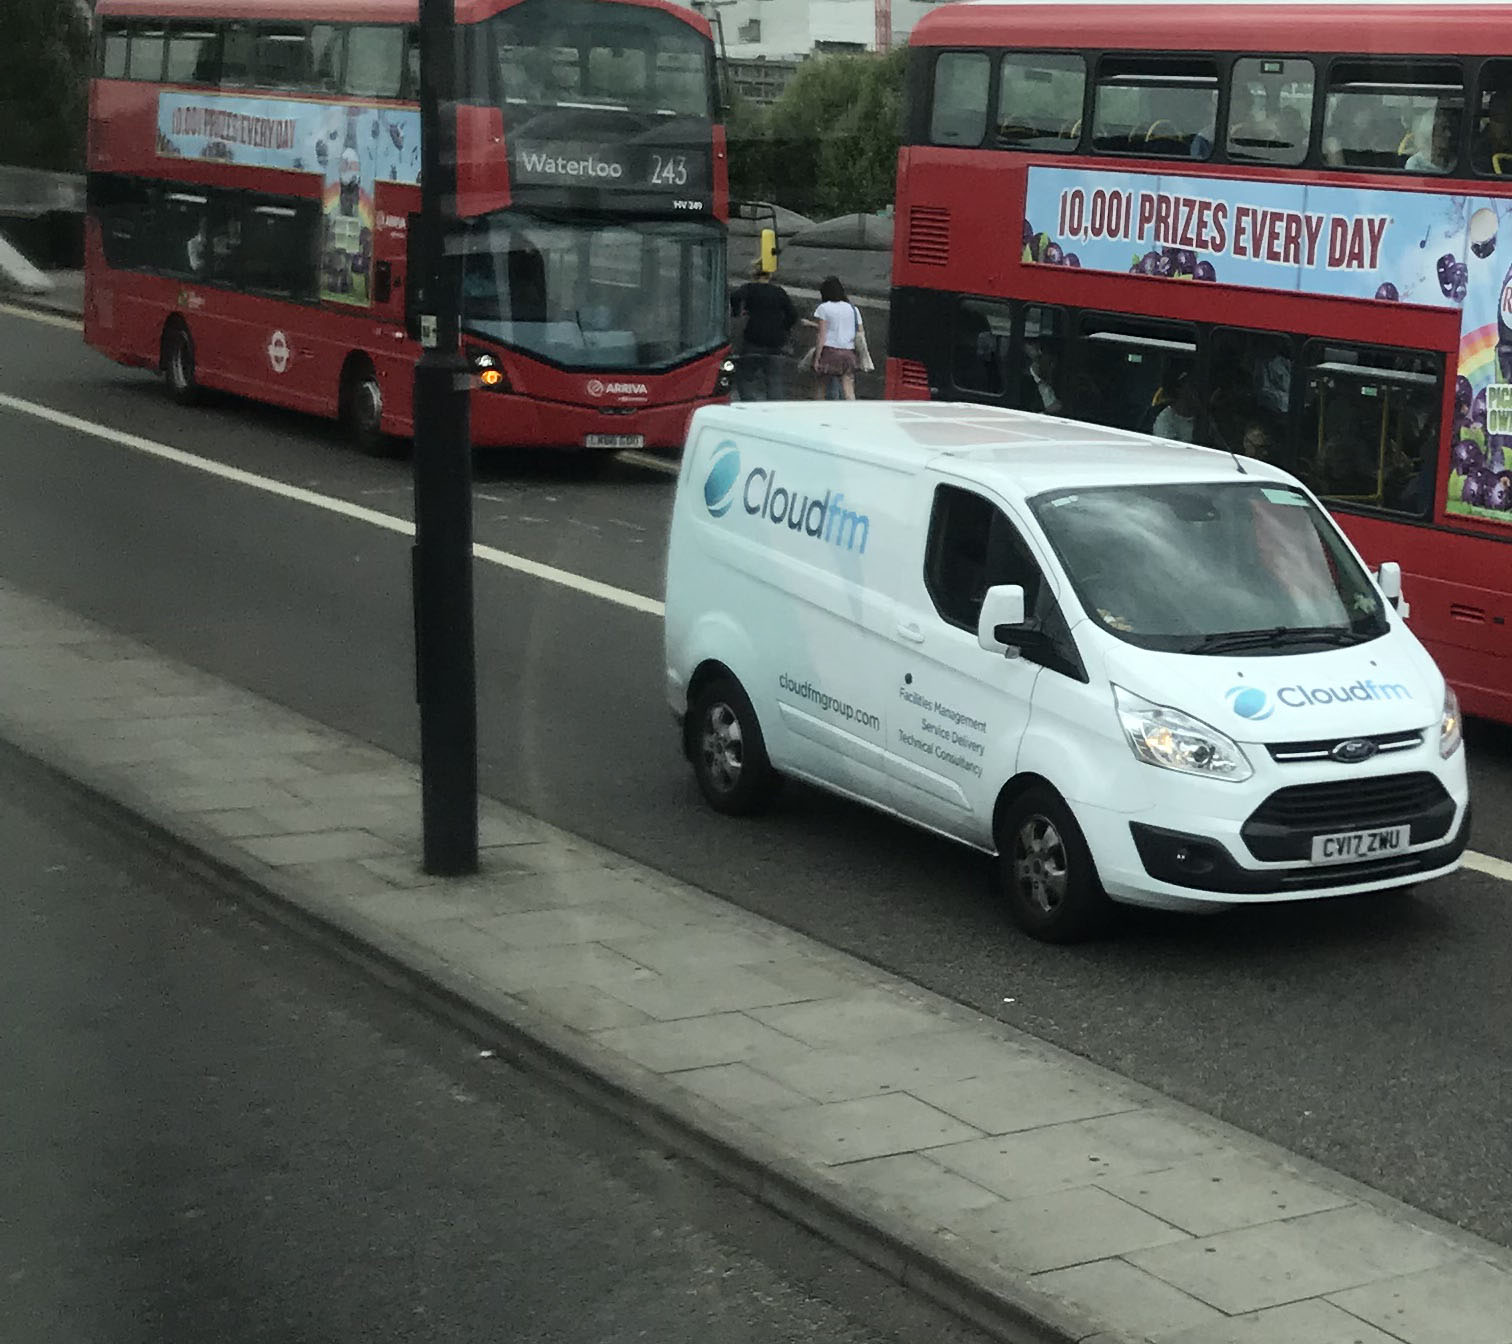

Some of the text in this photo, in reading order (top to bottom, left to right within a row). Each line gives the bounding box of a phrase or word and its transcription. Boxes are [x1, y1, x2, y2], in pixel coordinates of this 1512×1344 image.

[522, 151, 688, 186] Waterloo 243
[1058, 188, 1388, 270] 10,001 PRIZES EVERY DAY
[605, 382, 649, 395] ARRIVA
[743, 467, 870, 554] Cloudfm
[778, 672, 881, 732] cloudfmgroup.com
[899, 686, 988, 734] Facilities Management
[1276, 679, 1414, 708] Cloudfm
[898, 728, 984, 779] Technical Consultancy
[921, 717, 986, 757] Service Delivery
[1322, 834, 1364, 858] CV17
